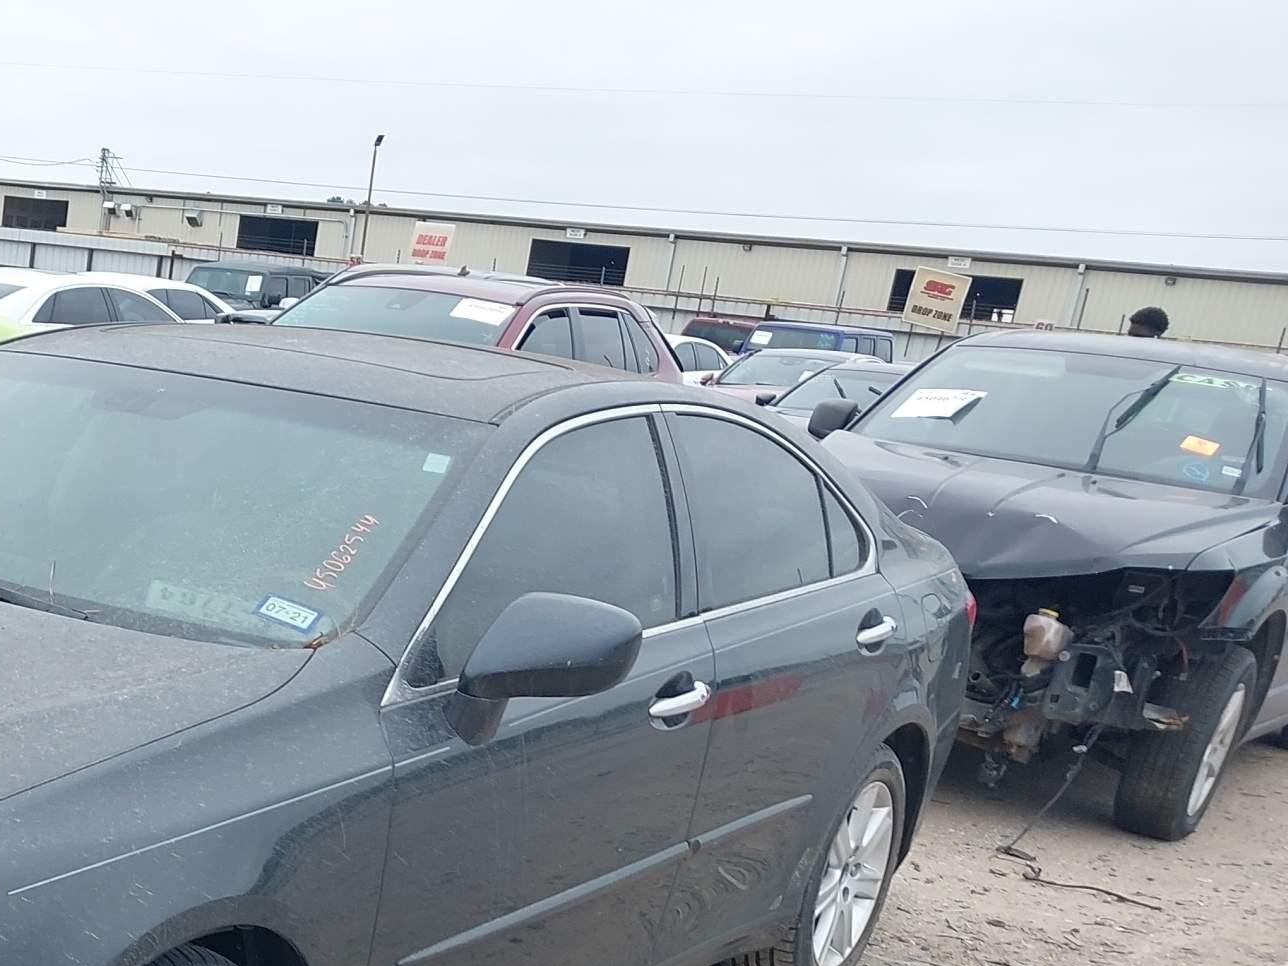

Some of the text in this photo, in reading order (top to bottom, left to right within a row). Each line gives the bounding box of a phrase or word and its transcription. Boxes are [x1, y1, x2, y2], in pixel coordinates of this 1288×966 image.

[416, 234, 448, 247] DEALER
[911, 304, 953, 322] DROP ZONE
[303, 514, 380, 591] 45062544
